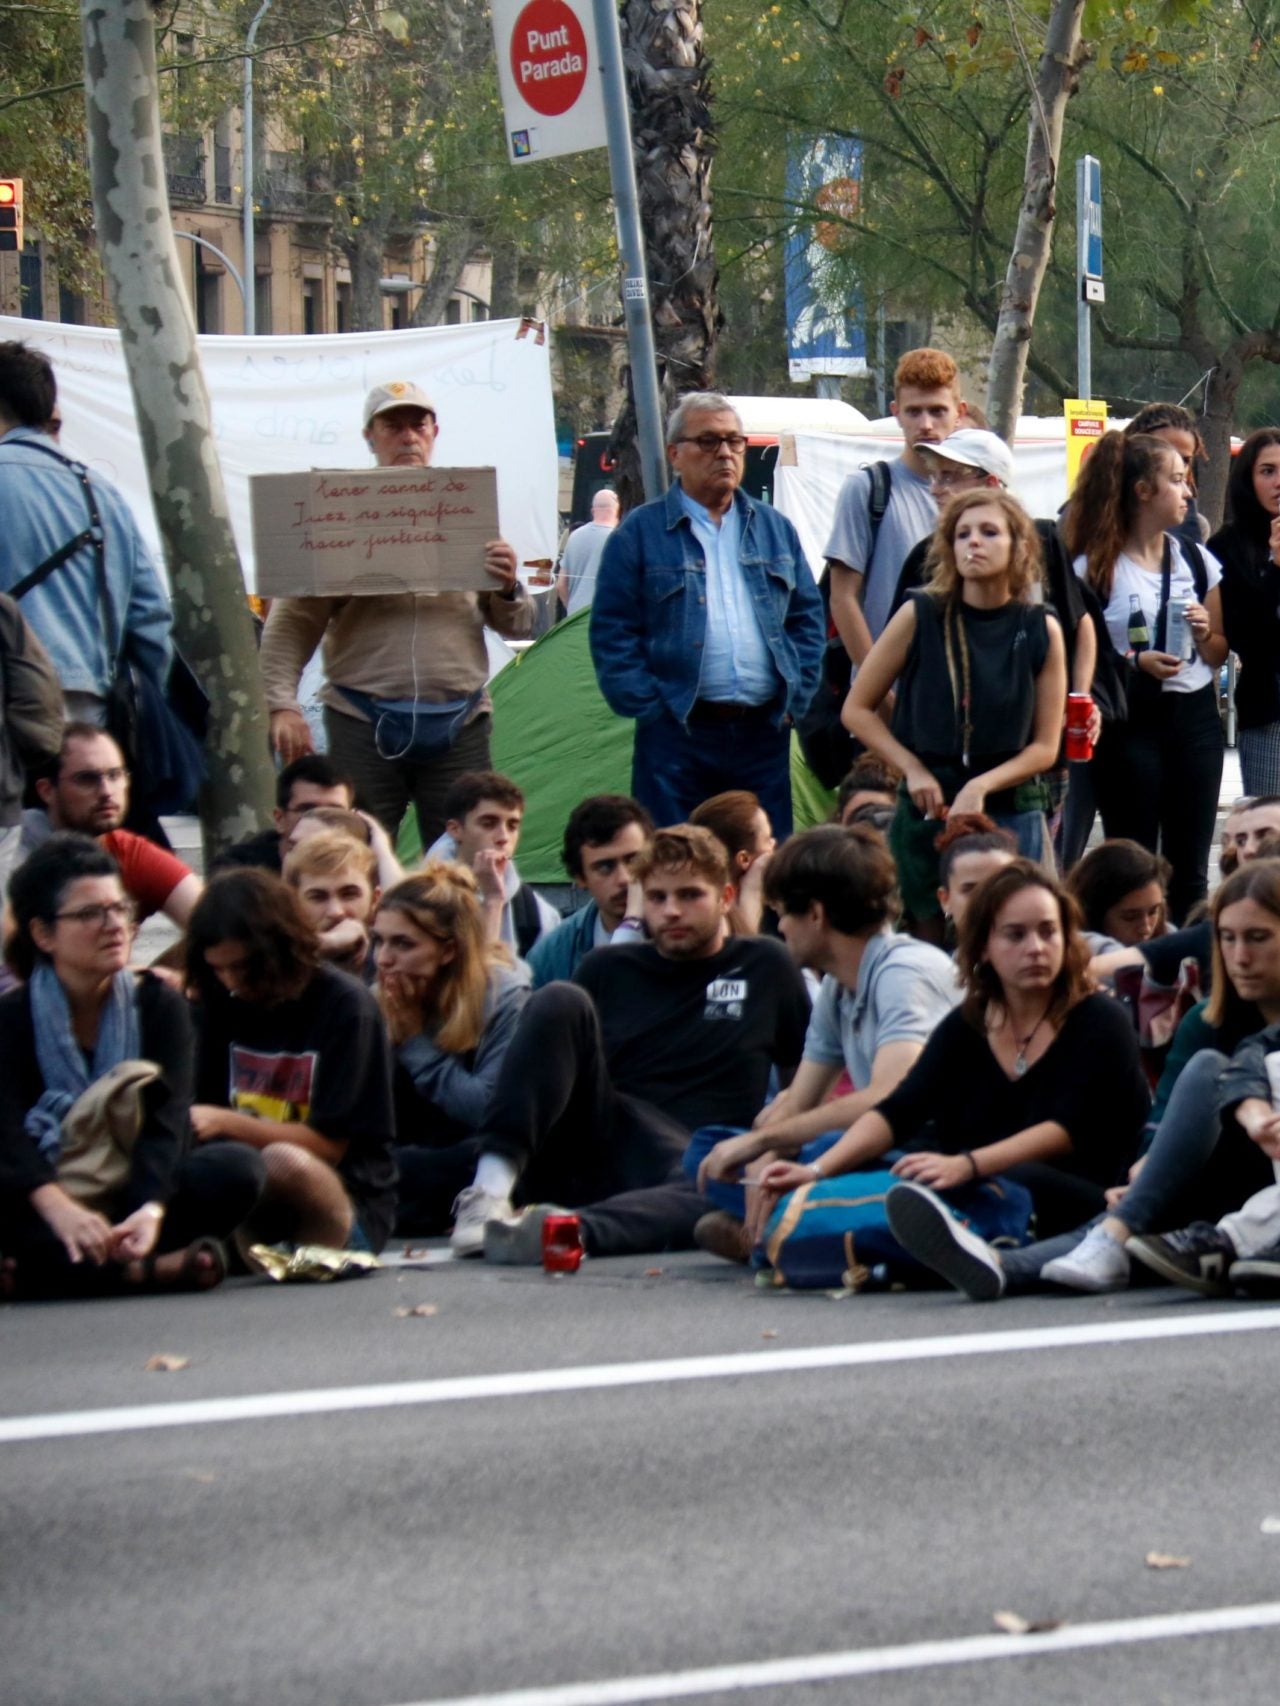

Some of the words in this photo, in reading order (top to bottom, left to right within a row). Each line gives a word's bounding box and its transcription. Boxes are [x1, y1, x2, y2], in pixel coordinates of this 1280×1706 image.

[527, 25, 569, 53] Punt
[519, 52, 583, 83] Parada
[377, 479, 437, 496] carnet
[441, 476, 469, 493] de
[355, 509, 381, 522] no
[386, 501, 476, 527] significa
[300, 530, 356, 551] hacer
[363, 529, 448, 559] justicia
